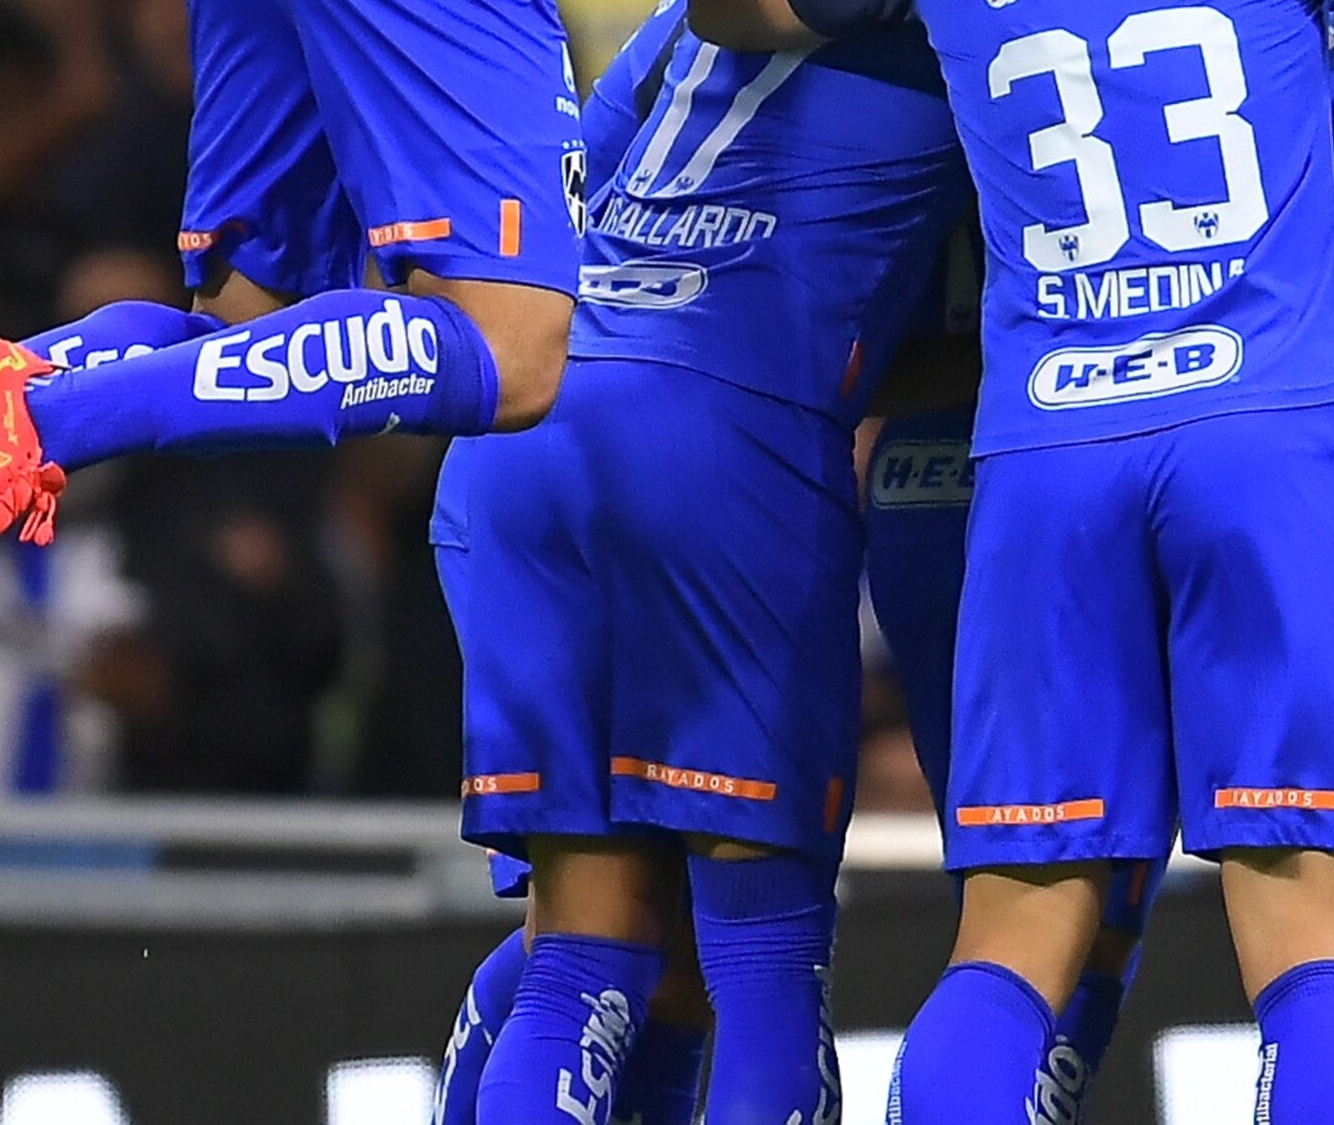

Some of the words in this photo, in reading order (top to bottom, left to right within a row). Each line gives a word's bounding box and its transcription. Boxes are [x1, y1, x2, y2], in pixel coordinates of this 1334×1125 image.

[988, 6, 1269, 272] 33
[193, 299, 439, 402] Escudo
[339, 376, 436, 410] Antibacter
[989, 805, 1066, 823] AYADOS
